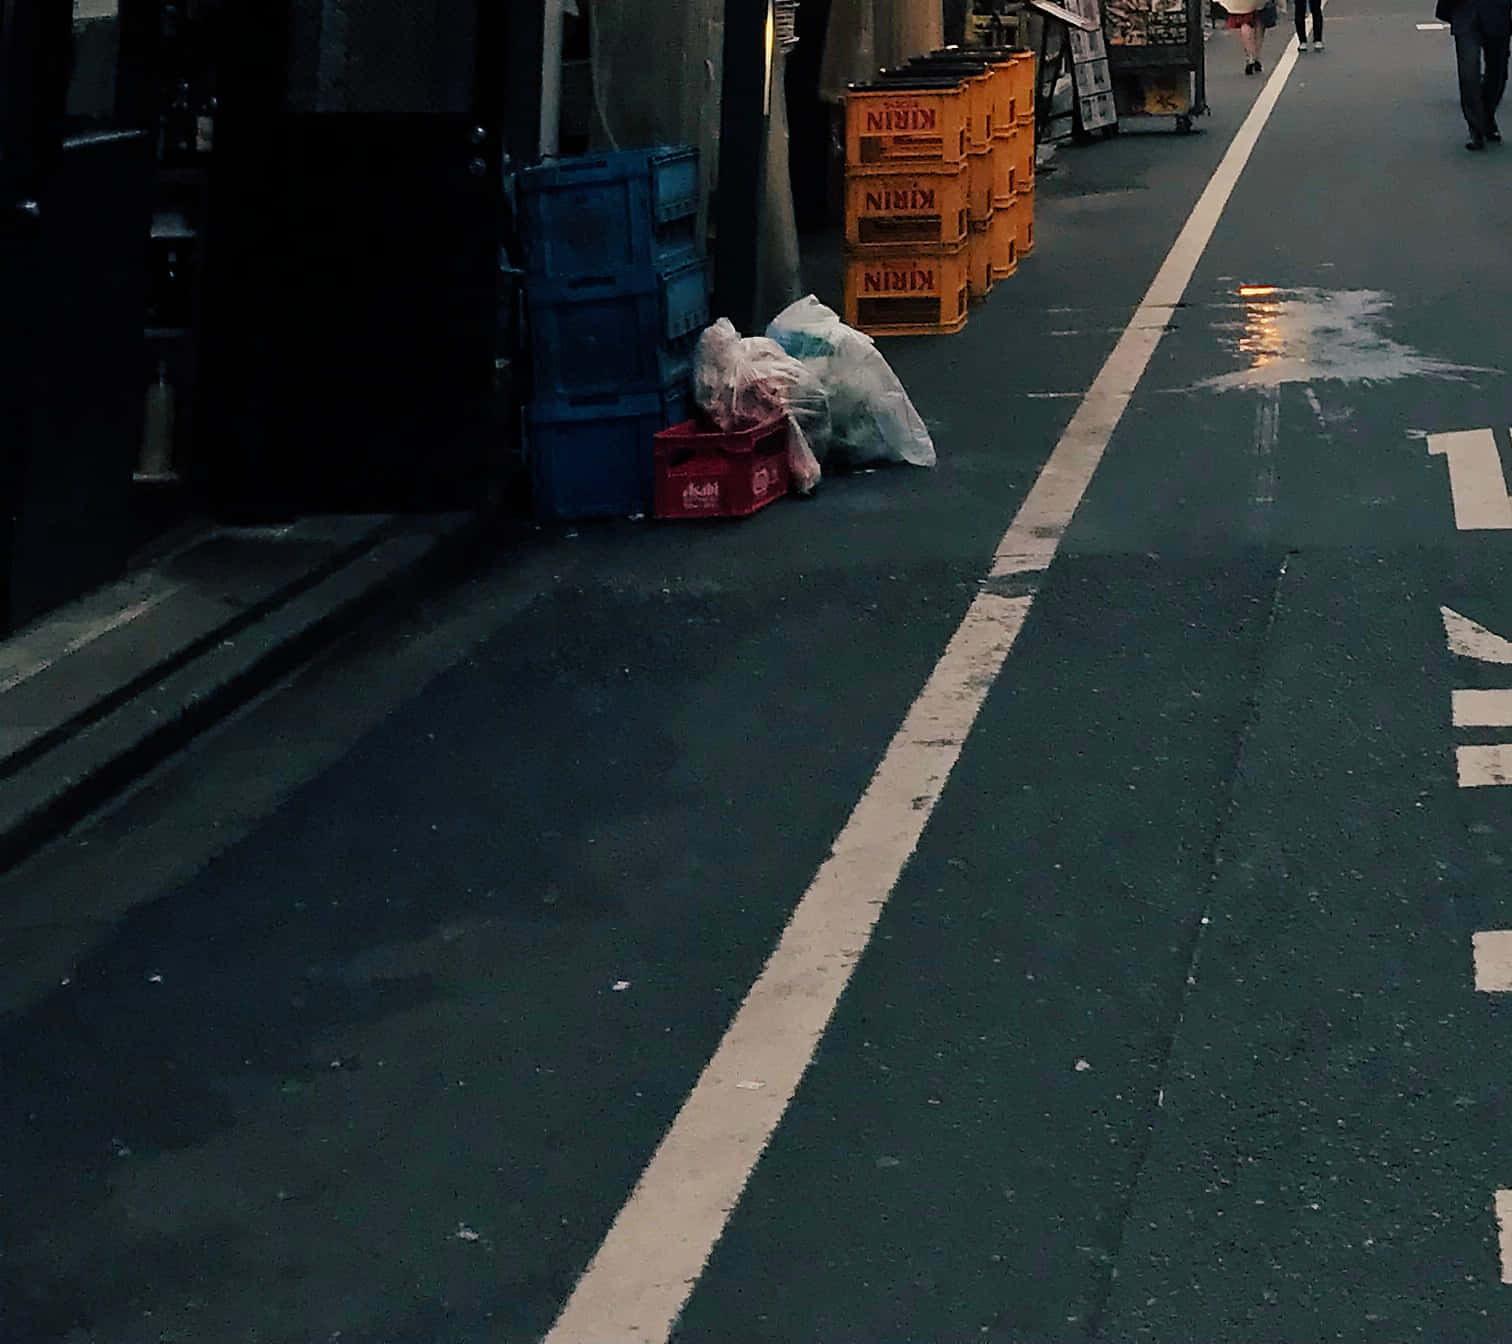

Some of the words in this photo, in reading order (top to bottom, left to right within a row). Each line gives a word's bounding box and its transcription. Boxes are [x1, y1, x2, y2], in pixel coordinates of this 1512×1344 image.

[866, 108, 936, 131] KIRIN
[865, 188, 935, 211] KIRIN
[863, 269, 935, 292] KIRIN
